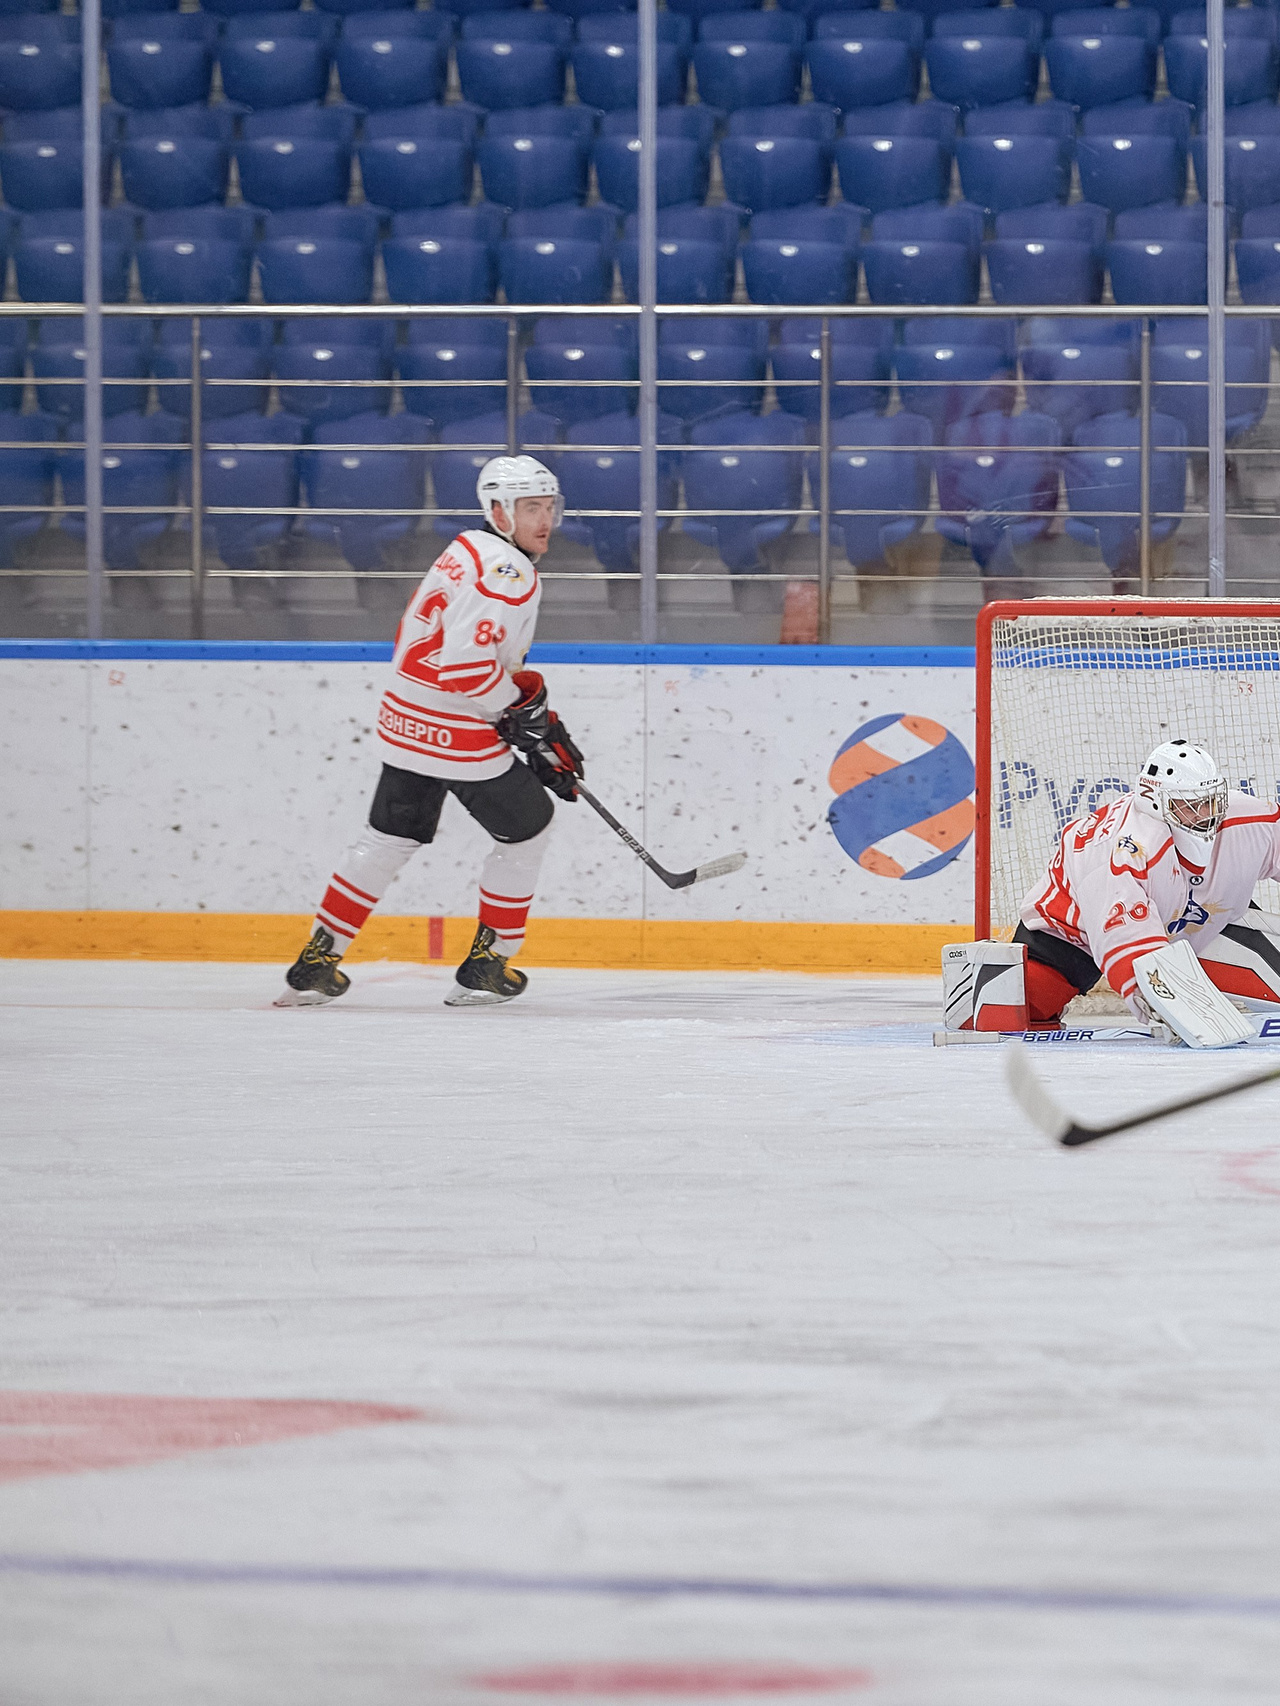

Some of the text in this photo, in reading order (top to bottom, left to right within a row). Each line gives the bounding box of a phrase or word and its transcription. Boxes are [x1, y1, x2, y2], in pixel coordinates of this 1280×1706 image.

[379, 707, 452, 747] ЭНЕРГО
[1139, 777, 1162, 788] FONBET
[1022, 1030, 1095, 1042] BAUER
